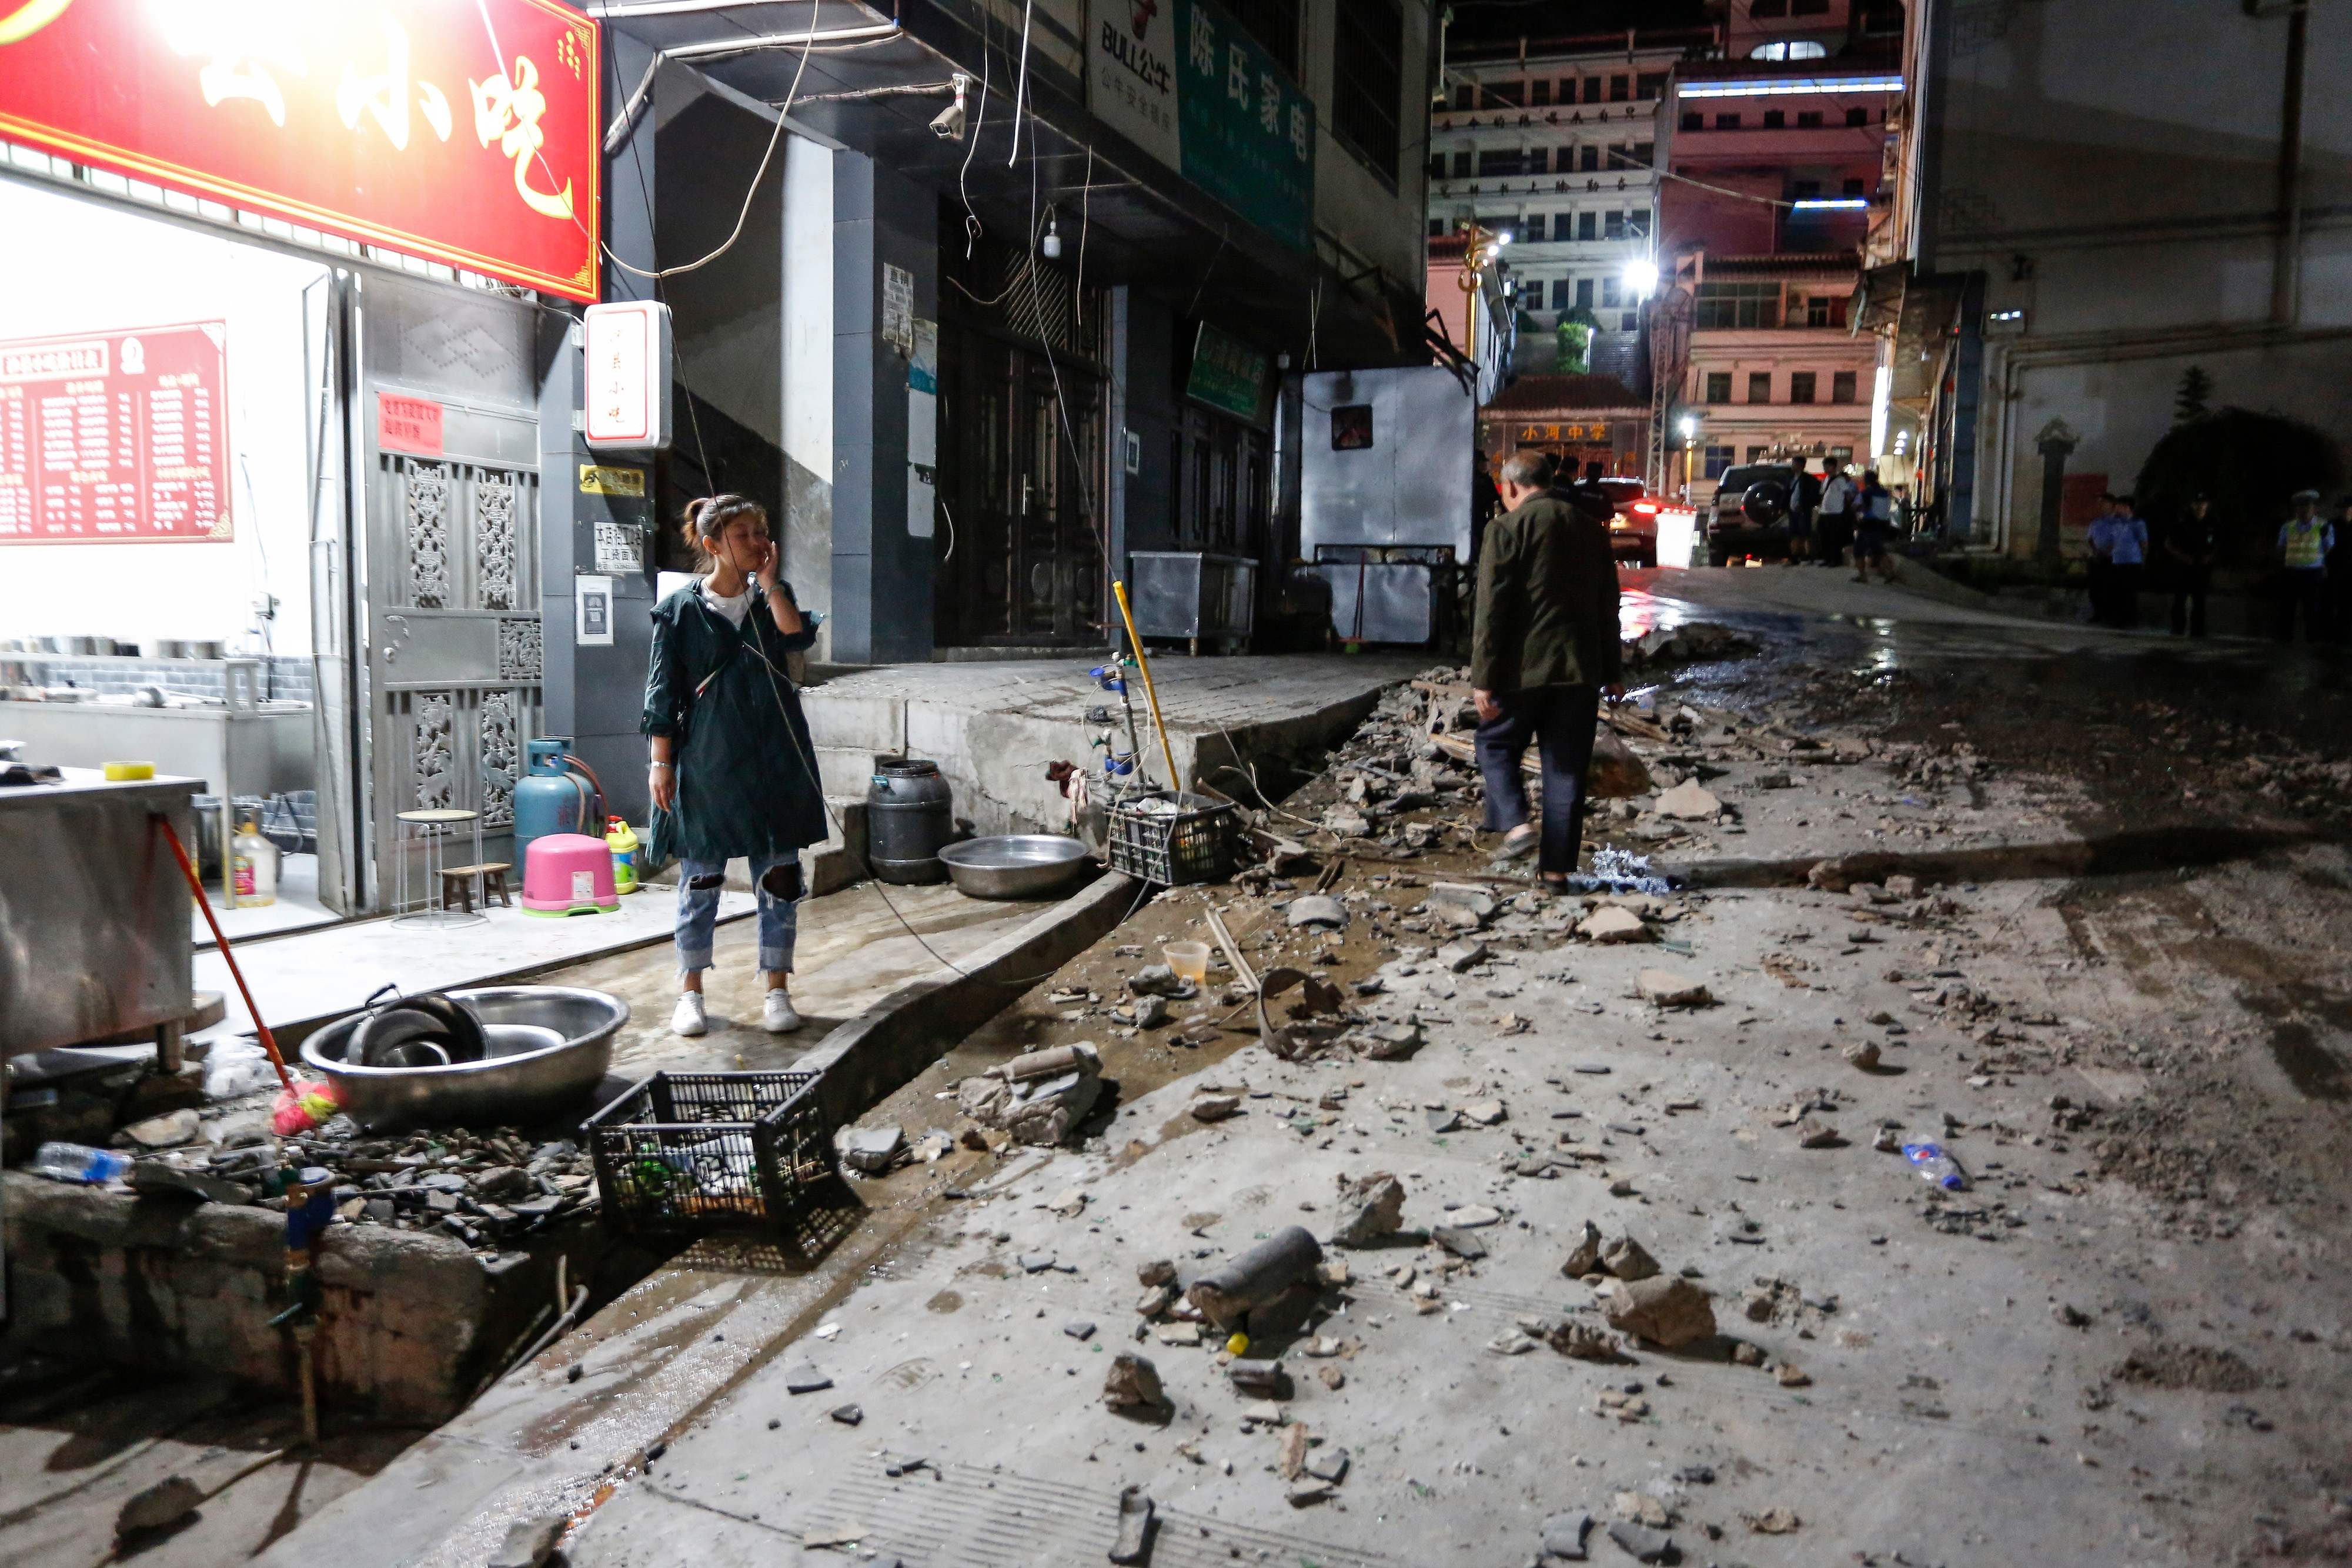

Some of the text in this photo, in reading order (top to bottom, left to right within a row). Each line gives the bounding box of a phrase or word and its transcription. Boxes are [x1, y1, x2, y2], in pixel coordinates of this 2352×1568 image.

[1190, 1, 1307, 163] 陈氏家电
[1522, 423, 1606, 440] 小河中学
[600, 547, 639, 560] 工资面议
